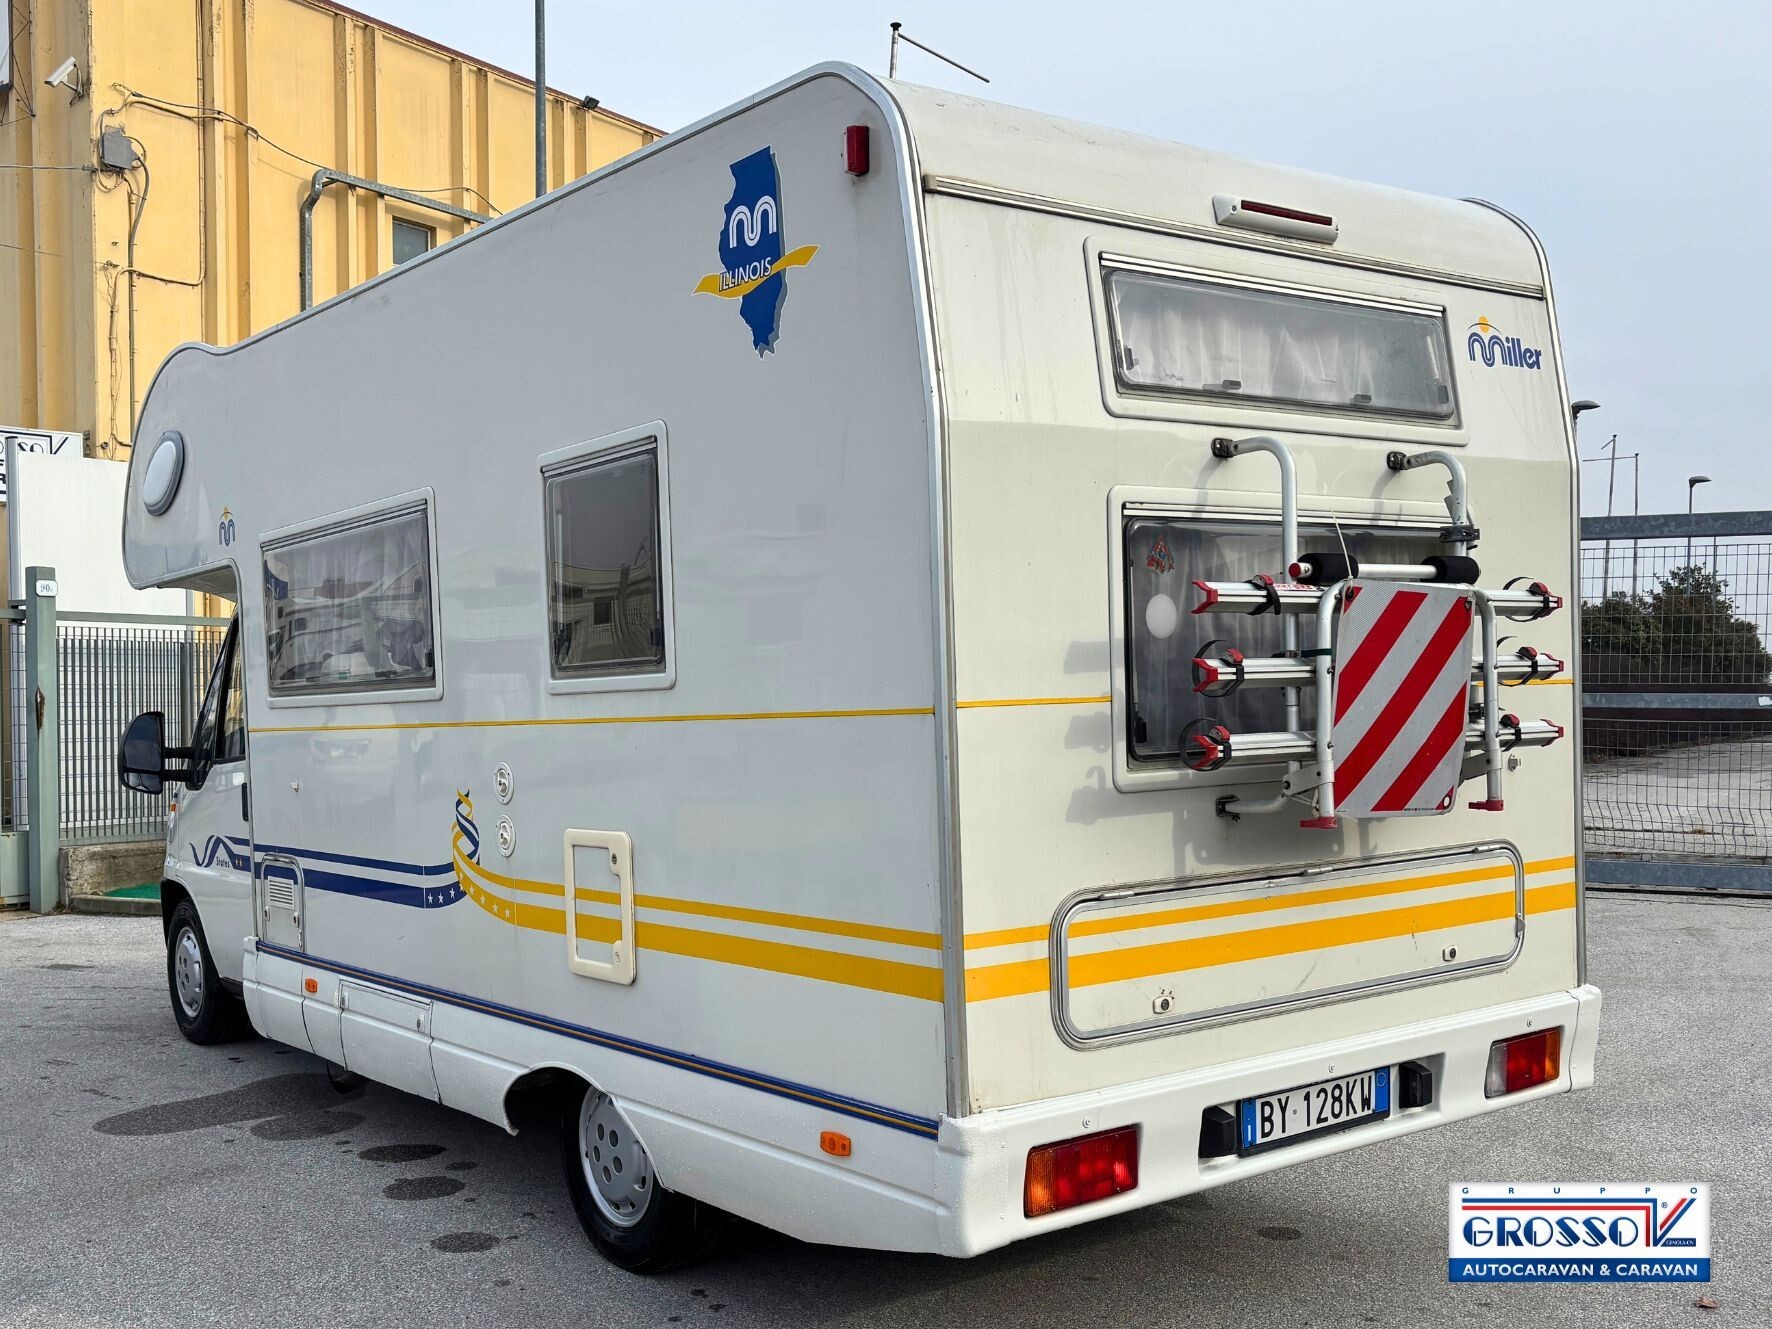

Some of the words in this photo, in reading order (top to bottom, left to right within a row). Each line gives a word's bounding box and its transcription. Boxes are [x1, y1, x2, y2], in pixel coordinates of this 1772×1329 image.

[719, 256, 773, 292] ILLINOIS
[1260, 1095, 1290, 1139] BY
[1303, 1075, 1373, 1127] 128KW
